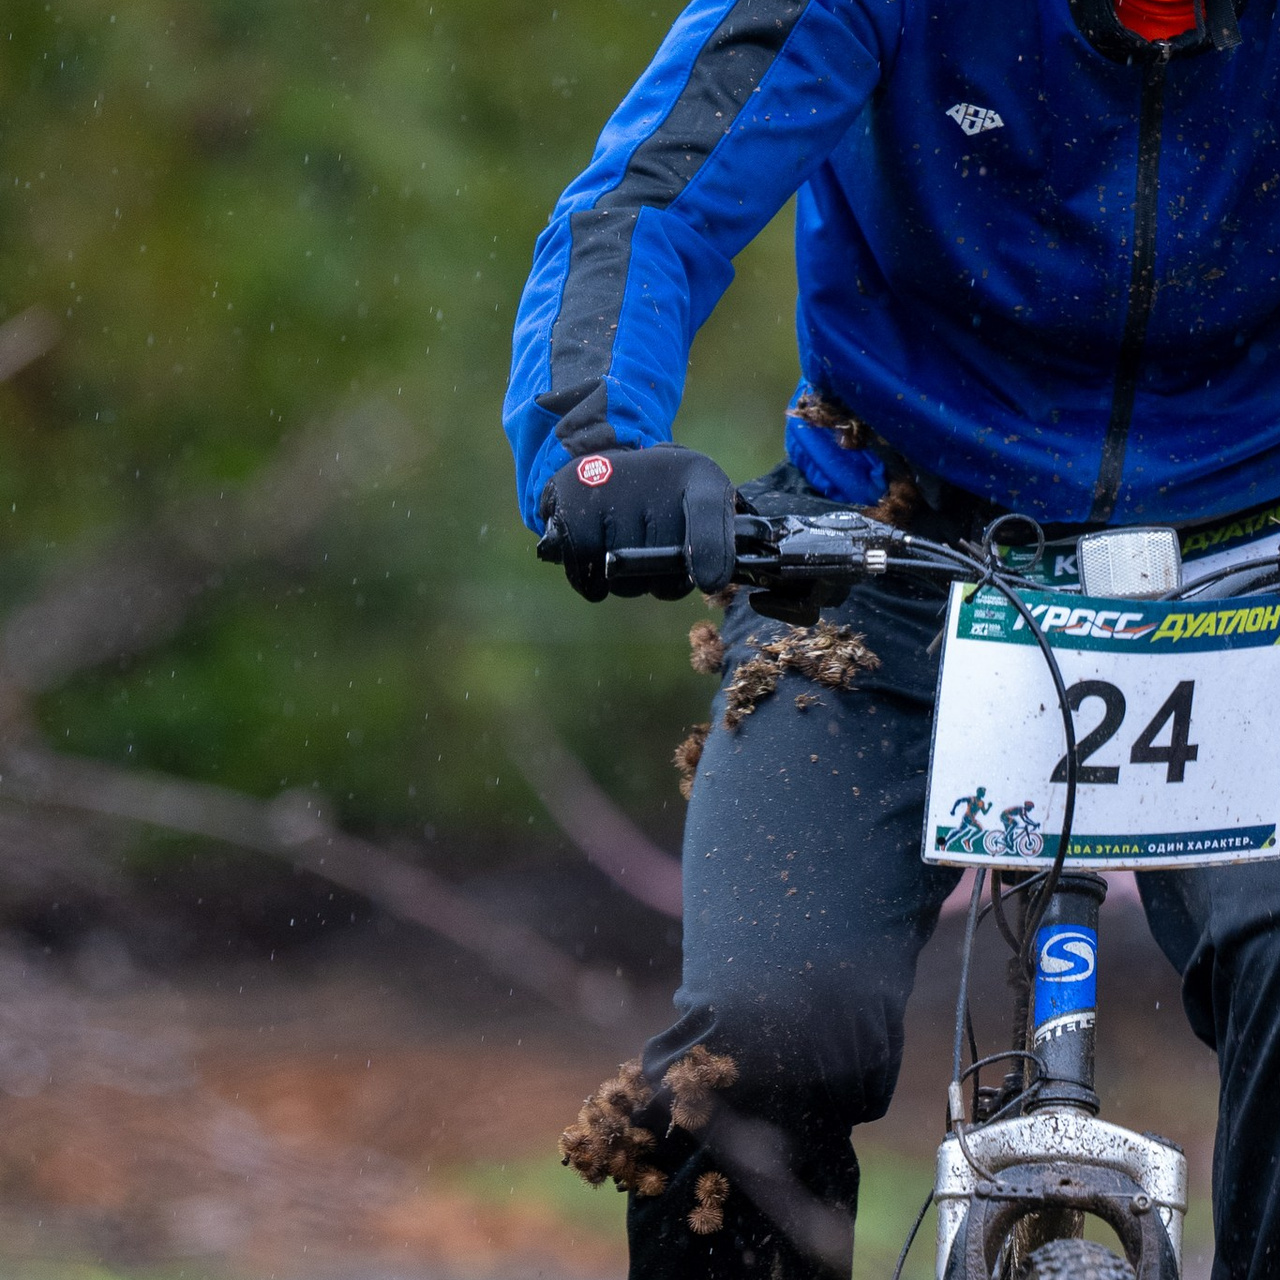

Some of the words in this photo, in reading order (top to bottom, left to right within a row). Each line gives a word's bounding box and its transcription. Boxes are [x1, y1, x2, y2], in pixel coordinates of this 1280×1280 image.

[1012, 603, 1144, 640] КРОСС
[1049, 680, 1199, 784] 24
[1095, 844, 1144, 854] ЭТАПА.
[1147, 842, 1184, 854] ОДИН
[1187, 836, 1254, 851] ХАРАКТЕР.
